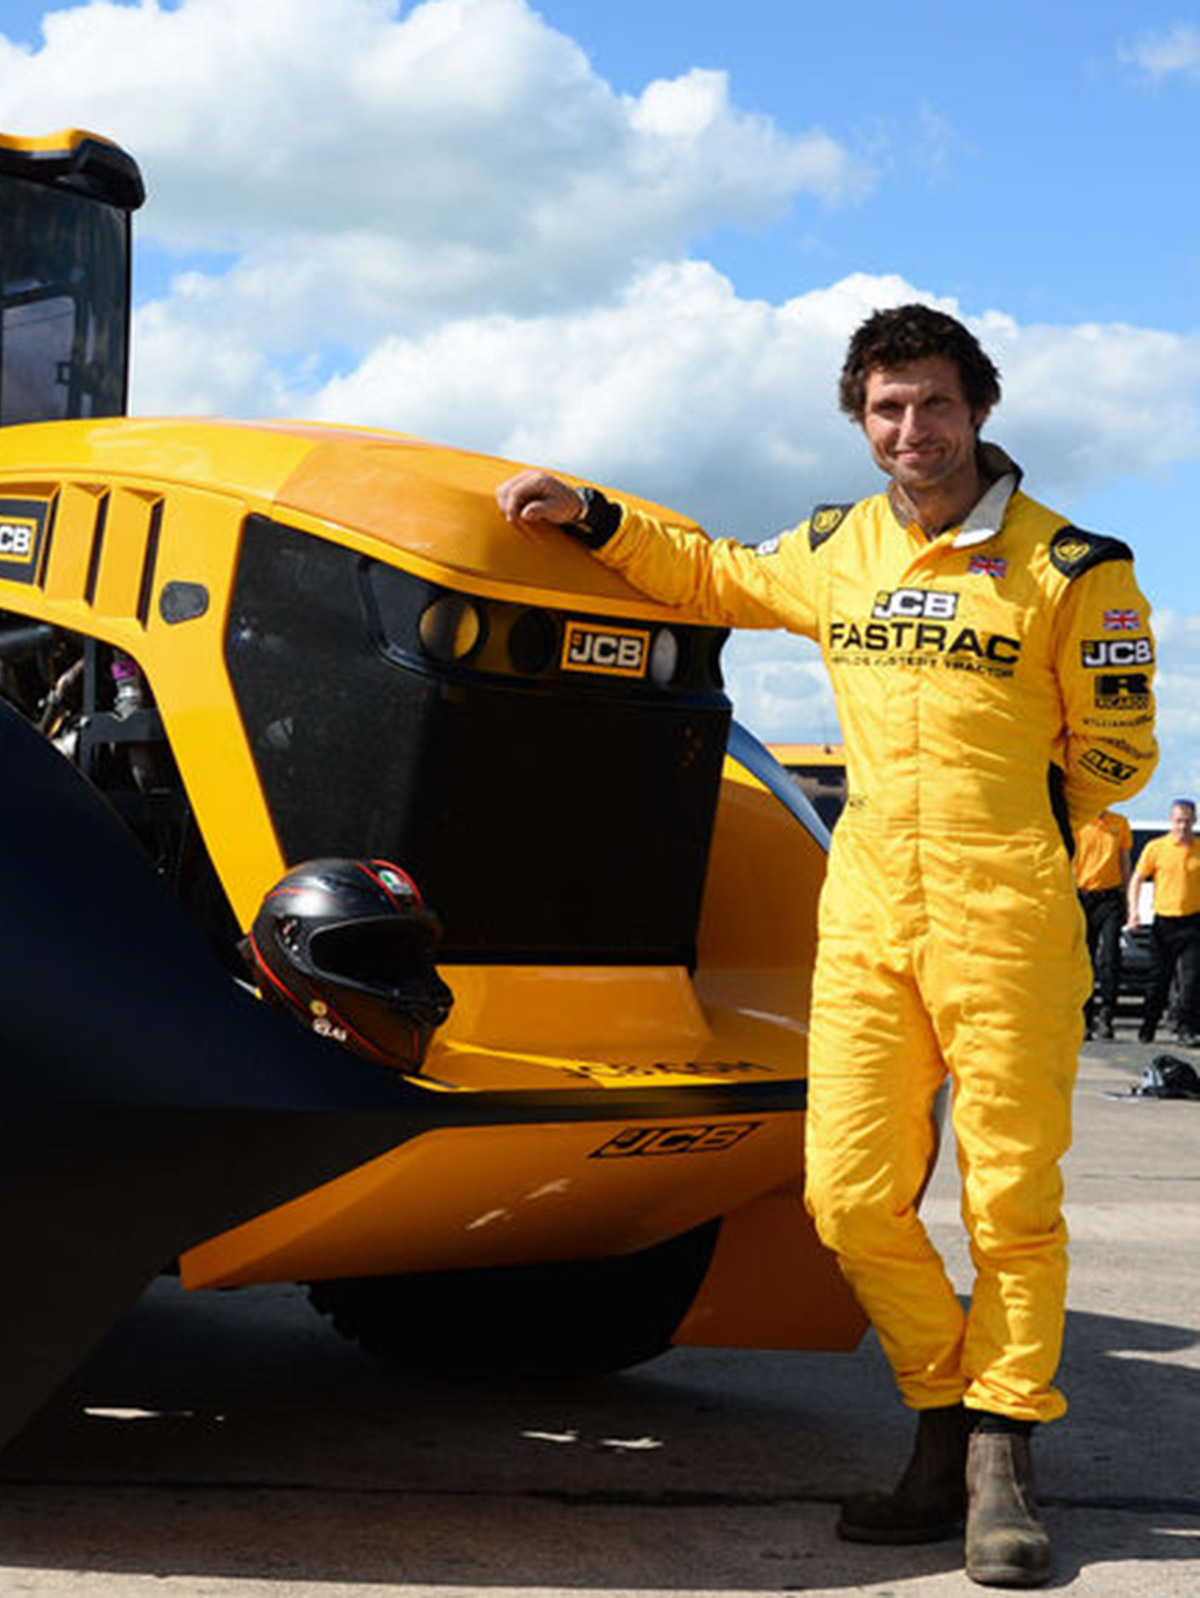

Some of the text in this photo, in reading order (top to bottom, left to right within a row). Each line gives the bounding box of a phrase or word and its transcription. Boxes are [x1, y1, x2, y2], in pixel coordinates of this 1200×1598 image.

[873, 590, 958, 619] JCB
[570, 633, 642, 668] JCB
[830, 622, 1022, 664] FASTRAC
[1084, 640, 1152, 666] JCB
[594, 1121, 760, 1158] JCB
